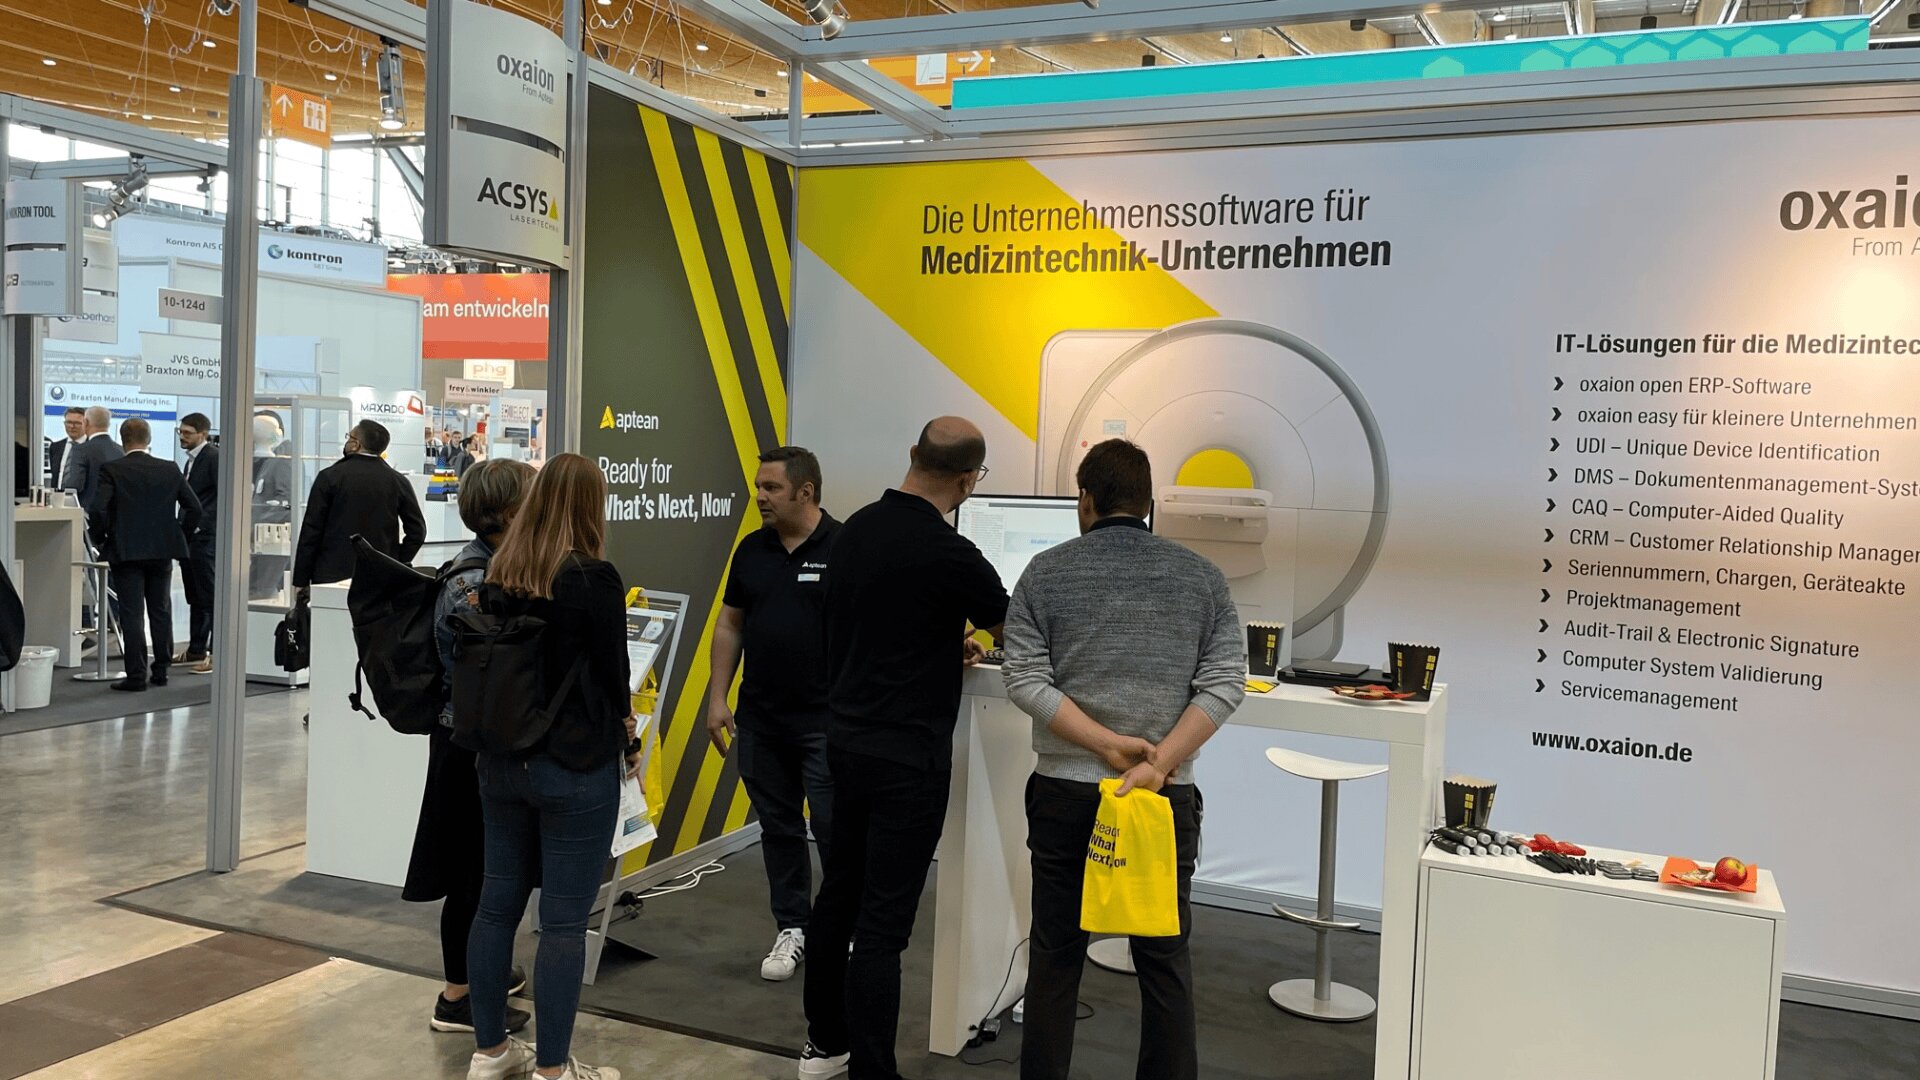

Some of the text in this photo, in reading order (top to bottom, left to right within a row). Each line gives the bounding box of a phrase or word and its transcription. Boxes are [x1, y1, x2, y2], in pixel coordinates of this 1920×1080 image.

[497, 54, 554, 93] oxaion
[477, 176, 548, 216] ACSYS
[1779, 174, 1920, 231] oxai
[33, 205, 56, 218] TOOL
[923, 188, 1370, 234] Die Unternehmenssoftware für
[165, 237, 201, 248] Kontron
[287, 246, 343, 264] kontron
[920, 236, 1391, 275] Medizintechnik-Unternehmen
[1852, 237, 1902, 256] From
[164, 296, 206, 311] 10-124d
[453, 297, 549, 318] entwickeln
[1555, 333, 1696, 357] IT-Lösungen
[1702, 333, 1736, 354] für
[1742, 334, 1779, 354] die
[146, 364, 184, 376] Braxton
[170, 354, 220, 367] JVS GmbH
[1579, 375, 1812, 397] oxaion open ERP-Software
[360, 403, 405, 415] MAXADO
[616, 410, 659, 433] aptean
[1578, 406, 1917, 431] oxaion easy für kleinere Unternehmen
[1575, 437, 1606, 454] UDI
[1626, 438, 1688, 459] Unique
[1693, 440, 1753, 458] Device
[1758, 441, 1881, 462] Identification
[598, 456, 673, 489] Ready for
[1574, 468, 1614, 485] DMS
[1634, 469, 1920, 498] Dokumentenmanagement-Syst
[658, 492, 698, 523] Next,
[1571, 498, 1608, 518] CAQ
[1628, 500, 1775, 524] Computer-Aided
[1780, 507, 1844, 530] Quality
[1569, 528, 1610, 547] CRM
[1629, 531, 1715, 552] Customer
[1719, 536, 1834, 559] Relationship
[1838, 542, 1920, 565] Manage
[1567, 558, 1906, 597] Seriennummern, Chargen, Geräteakte
[1566, 589, 1742, 617] Projektmanagement
[1563, 620, 1860, 658] Audit-Trail & Electronic Signature
[1562, 650, 1823, 690] Computer System Validierung
[1560, 680, 1739, 712] Servicemanagement
[1531, 730, 1693, 763] www.oxaion.de
